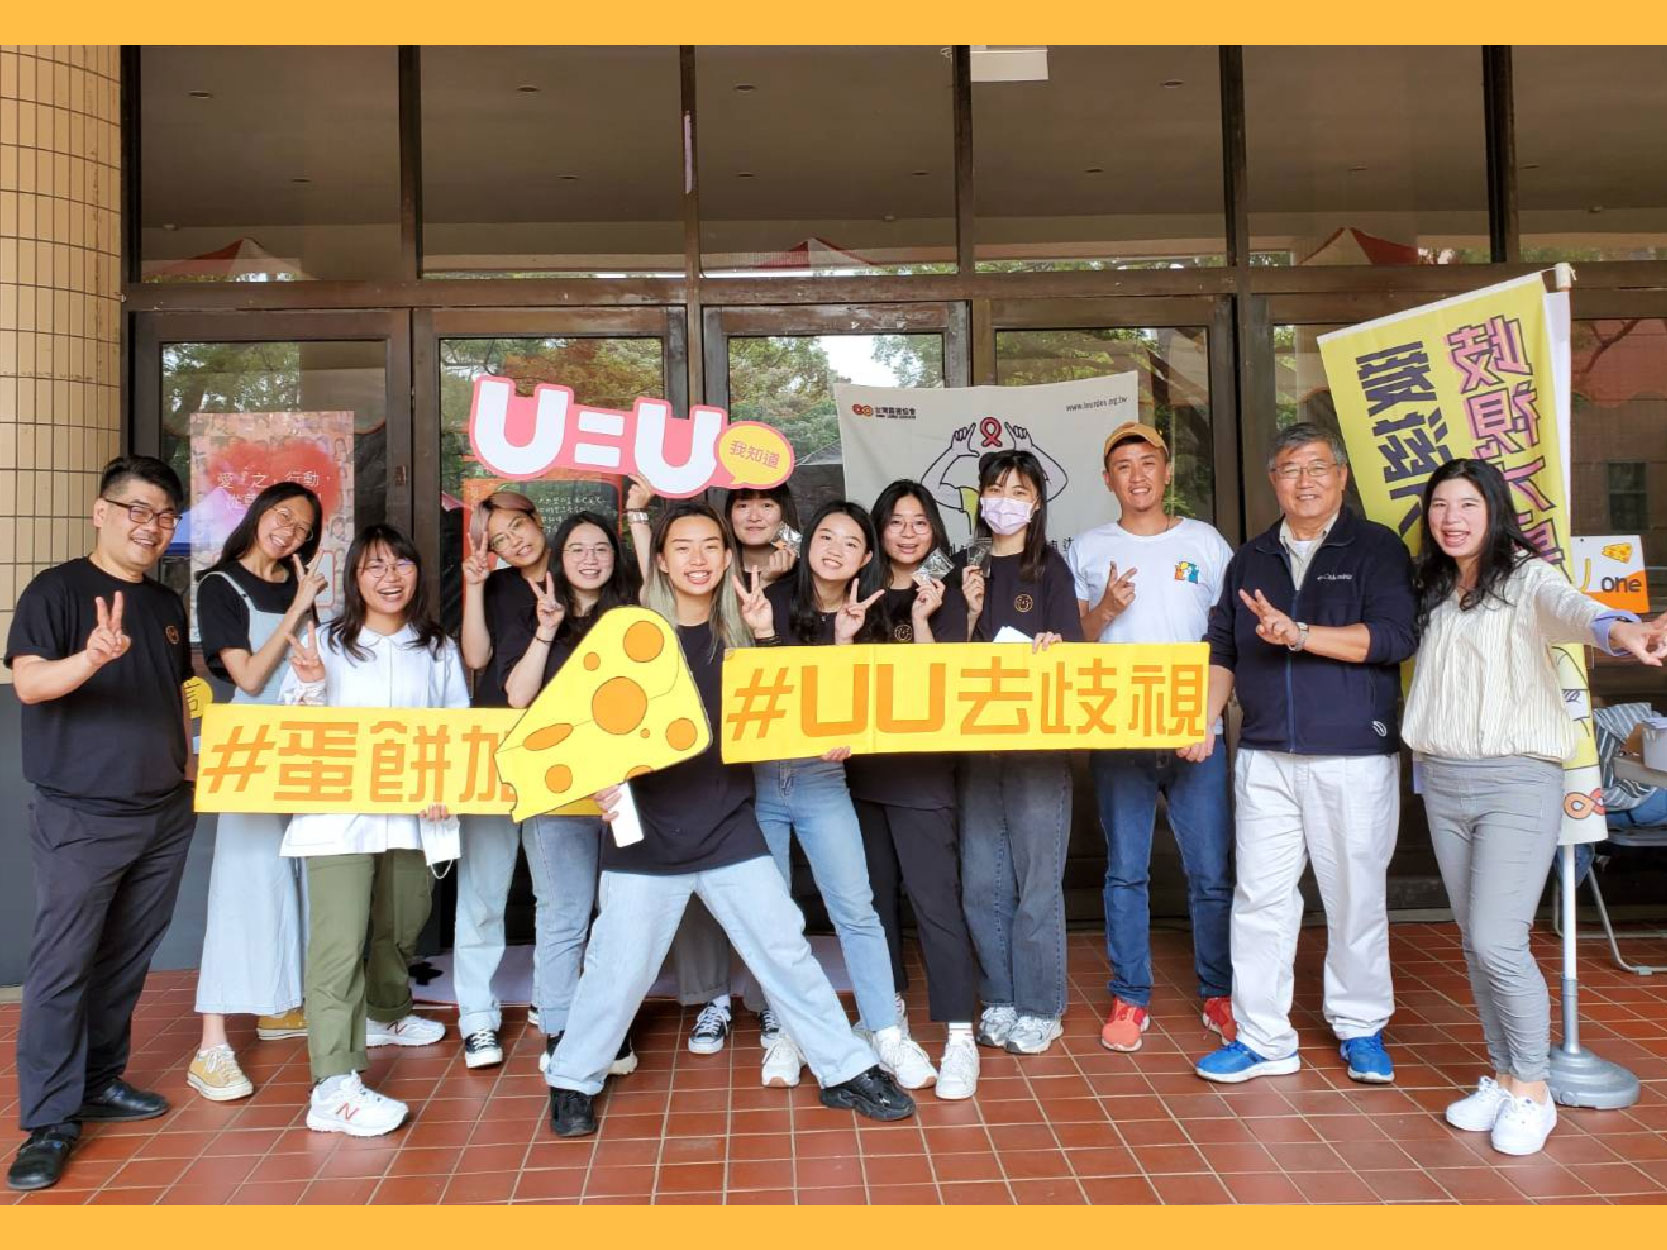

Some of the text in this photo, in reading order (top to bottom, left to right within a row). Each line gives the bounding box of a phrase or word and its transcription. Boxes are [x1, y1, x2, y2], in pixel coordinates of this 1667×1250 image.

[474, 381, 722, 494] U=U
[729, 440, 780, 469] 我知道
[726, 656, 1205, 741] #UU去歧視
